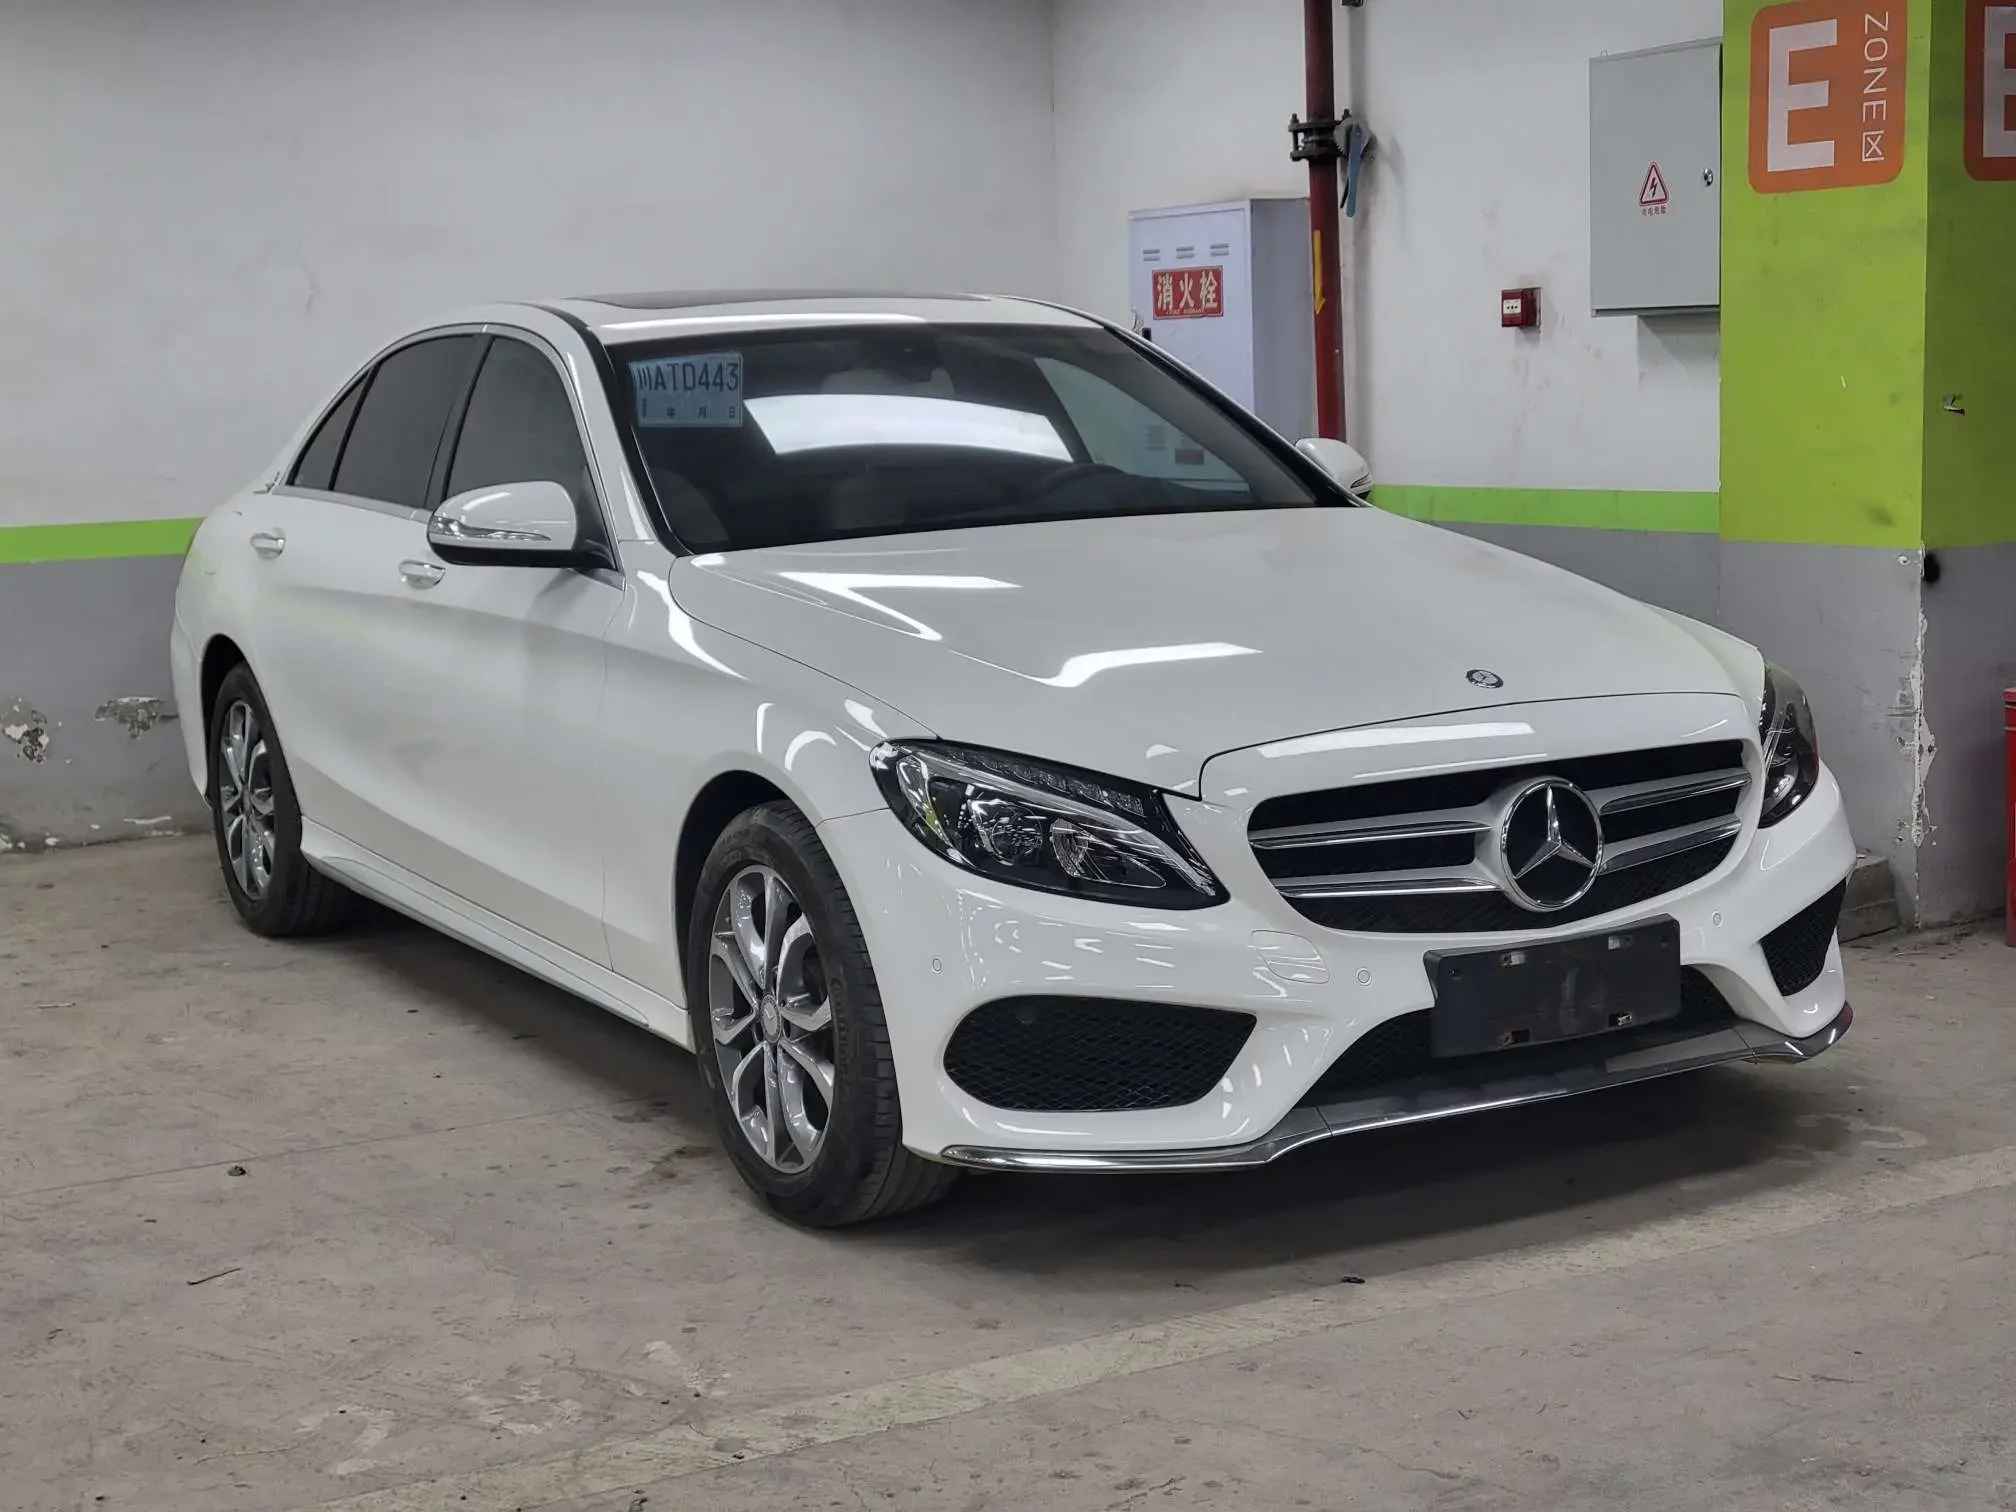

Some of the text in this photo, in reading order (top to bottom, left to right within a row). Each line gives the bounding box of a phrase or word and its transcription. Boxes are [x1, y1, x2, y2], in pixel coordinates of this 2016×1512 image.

[1768, 19, 1837, 171] E
[1157, 271, 1217, 312] 消火栓
